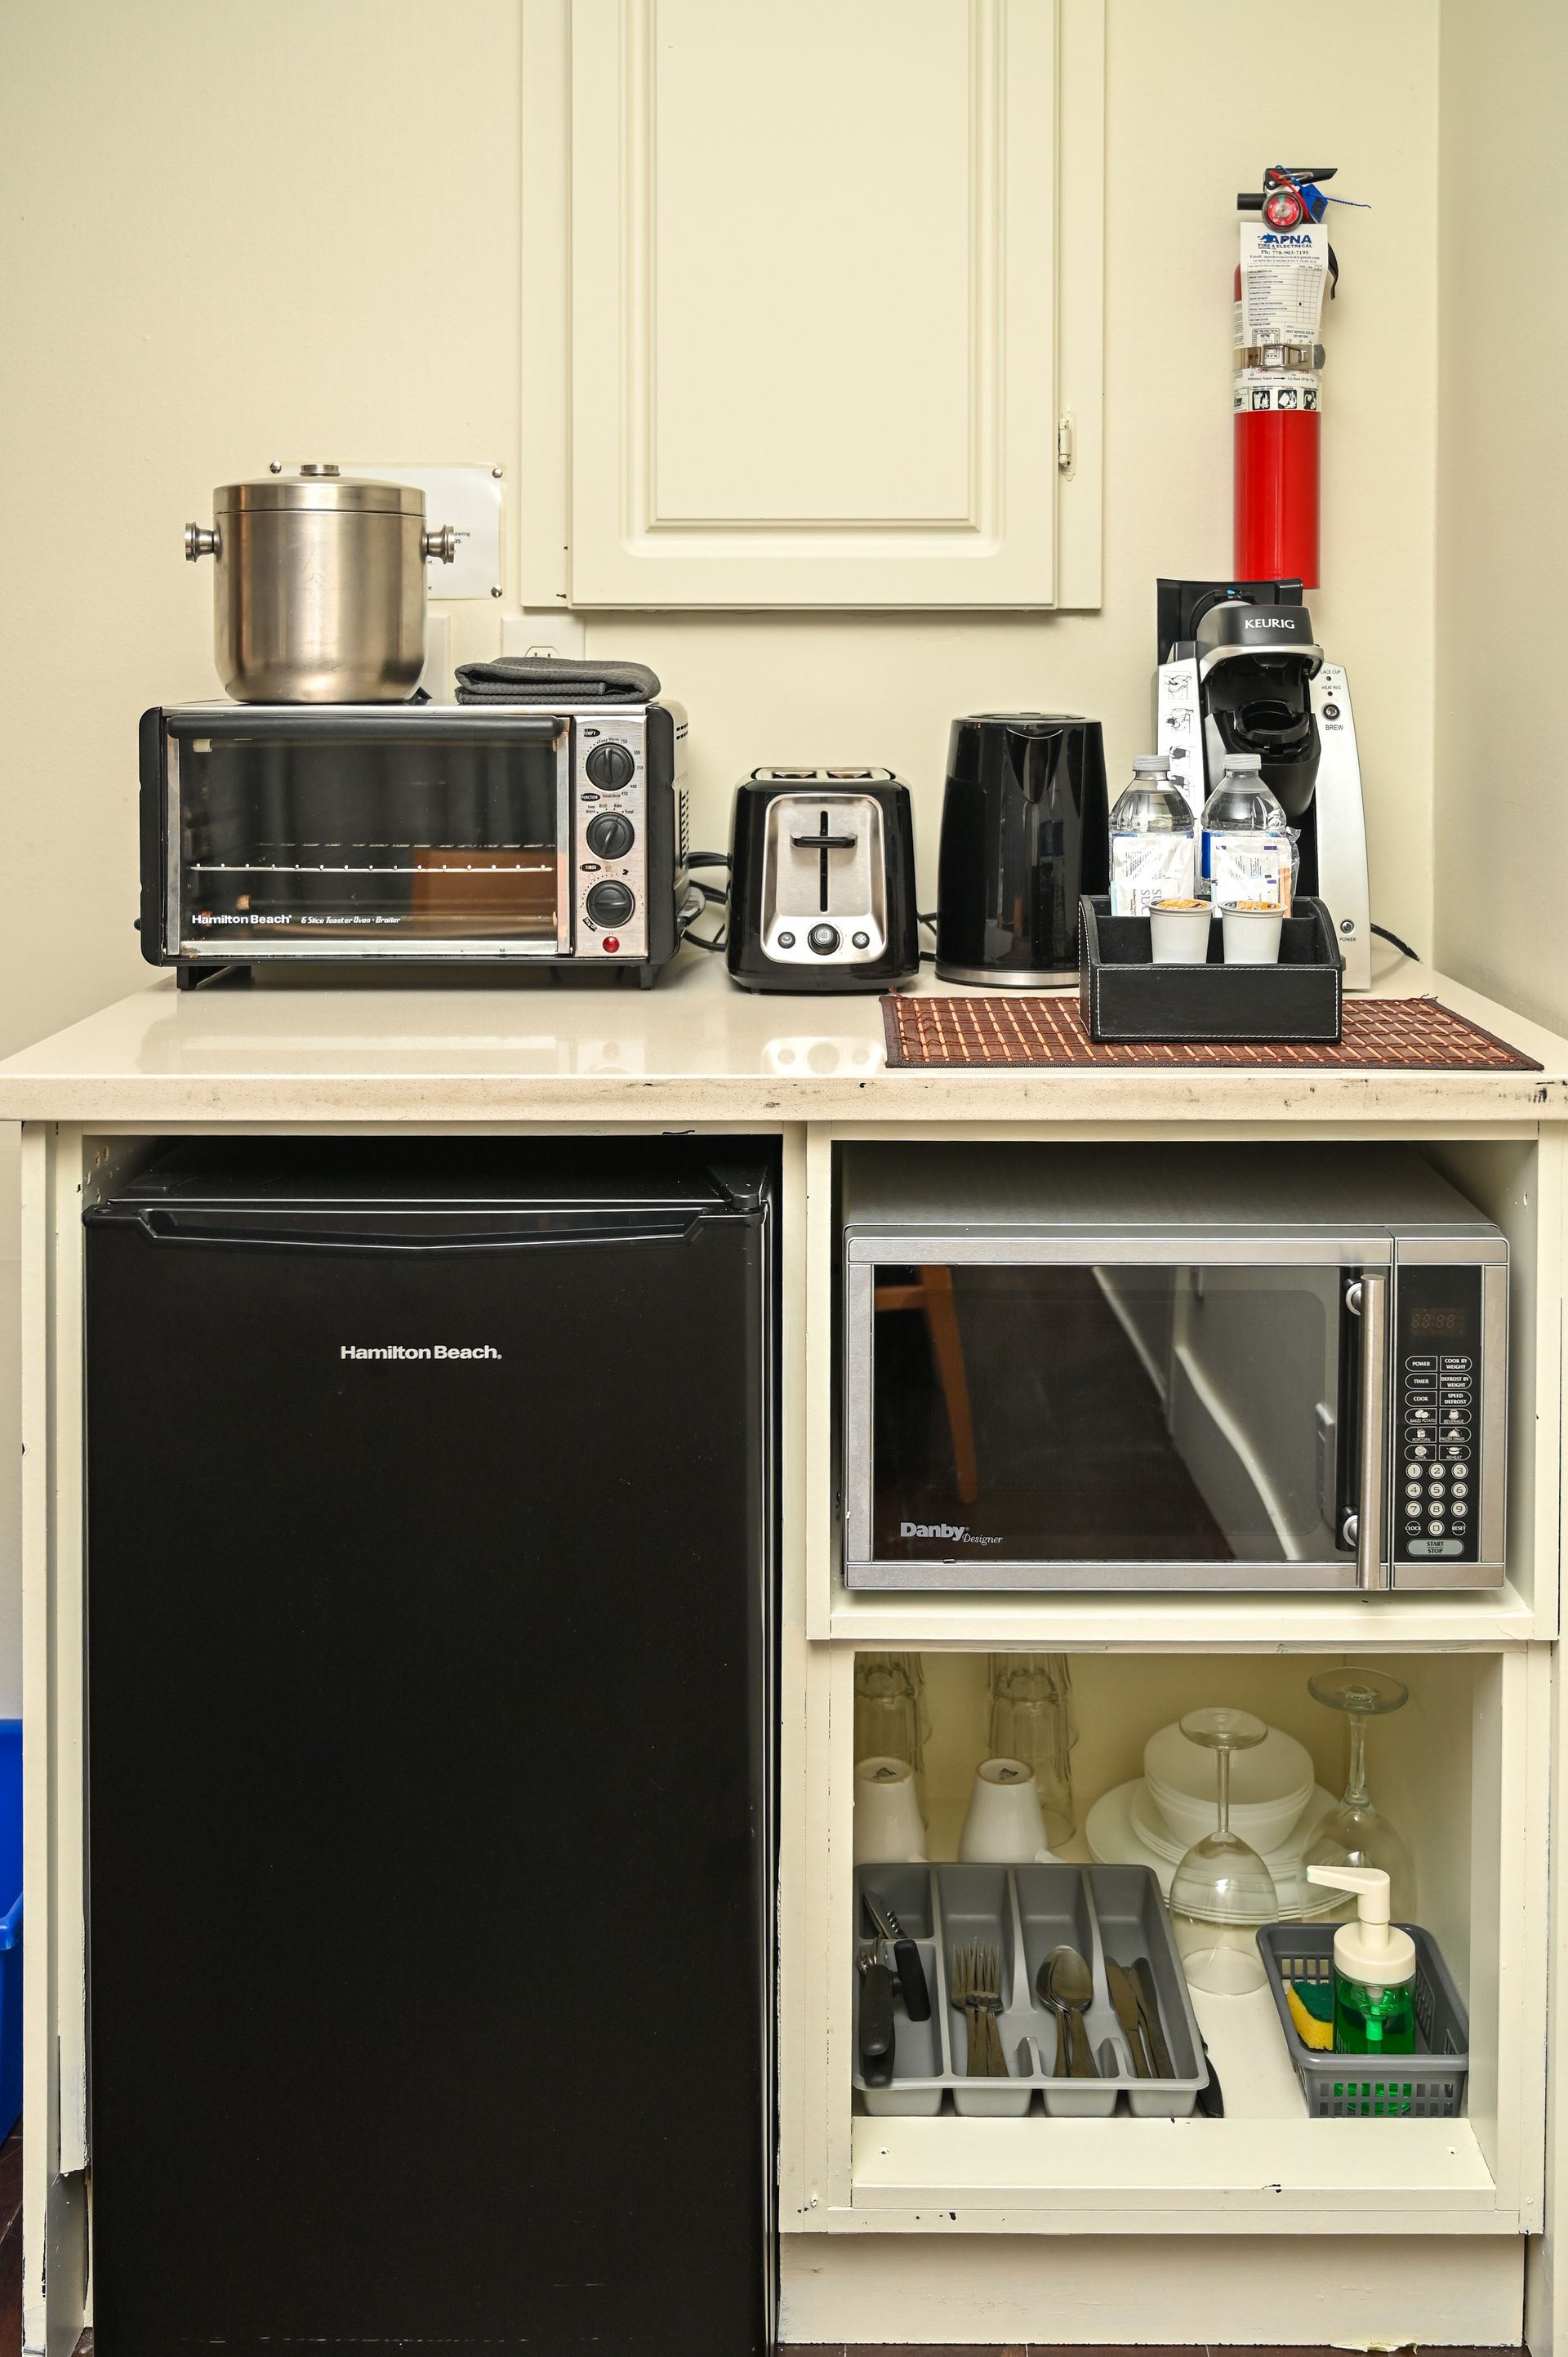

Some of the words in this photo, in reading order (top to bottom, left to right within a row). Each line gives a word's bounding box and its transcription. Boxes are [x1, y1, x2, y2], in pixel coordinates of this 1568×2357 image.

[1271, 234, 1312, 244] APNA
[1245, 618, 1295, 629] KEURIG
[192, 914, 248, 924] Hamilton
[250, 914, 290, 924] Beach
[341, 1346, 431, 1359] Hamilton
[434, 1345, 497, 1359] Beach
[900, 1522, 966, 1542] Danby
[962, 1533, 1004, 1546] Designer
